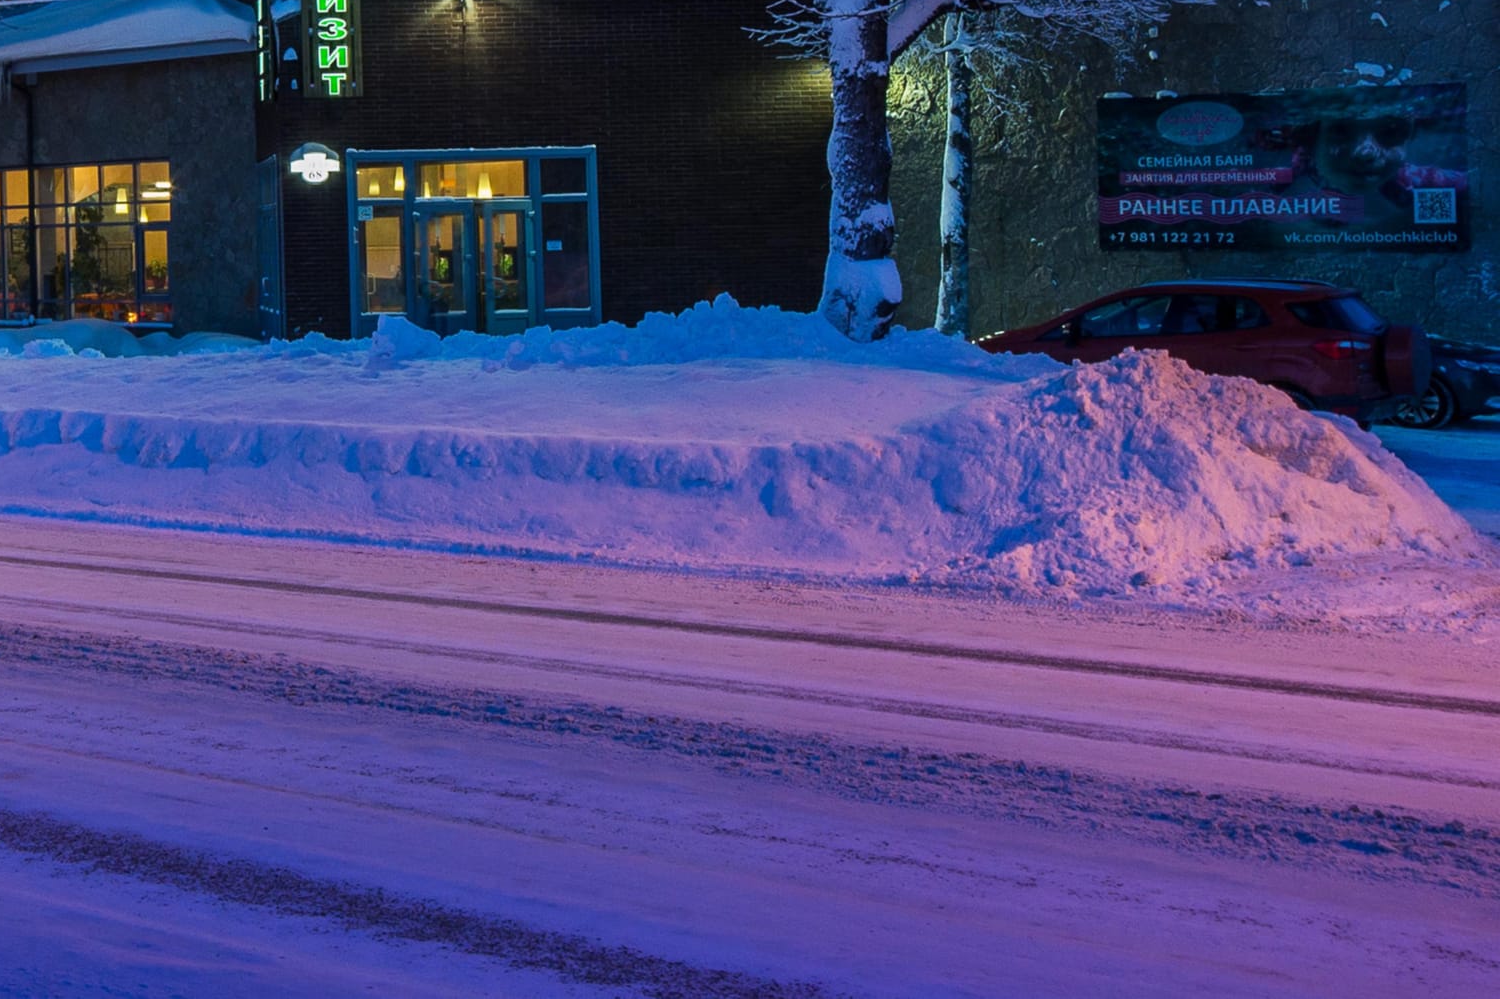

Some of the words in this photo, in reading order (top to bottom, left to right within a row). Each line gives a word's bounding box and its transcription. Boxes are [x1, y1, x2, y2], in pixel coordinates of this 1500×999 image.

[1137, 154, 1212, 168] СЕМЕЙНАЯ
[1215, 154, 1253, 167] БАНЯ
[1125, 173, 1173, 184] ЗАНЯТИЯ
[1175, 173, 1199, 185] ДЛЯ
[1200, 171, 1277, 183] БЕРЕМЕННЫХ
[1118, 199, 1204, 216] РАННЕЕ
[1211, 198, 1341, 215] ПЛАВАНИЕ
[1109, 232, 1125, 243] +7
[1129, 232, 1156, 243] 981
[1162, 232, 1188, 243] 122
[1192, 232, 1210, 243] 21
[1216, 232, 1235, 243] 72
[1284, 231, 1458, 244] vk.com/kolobochkiclub
